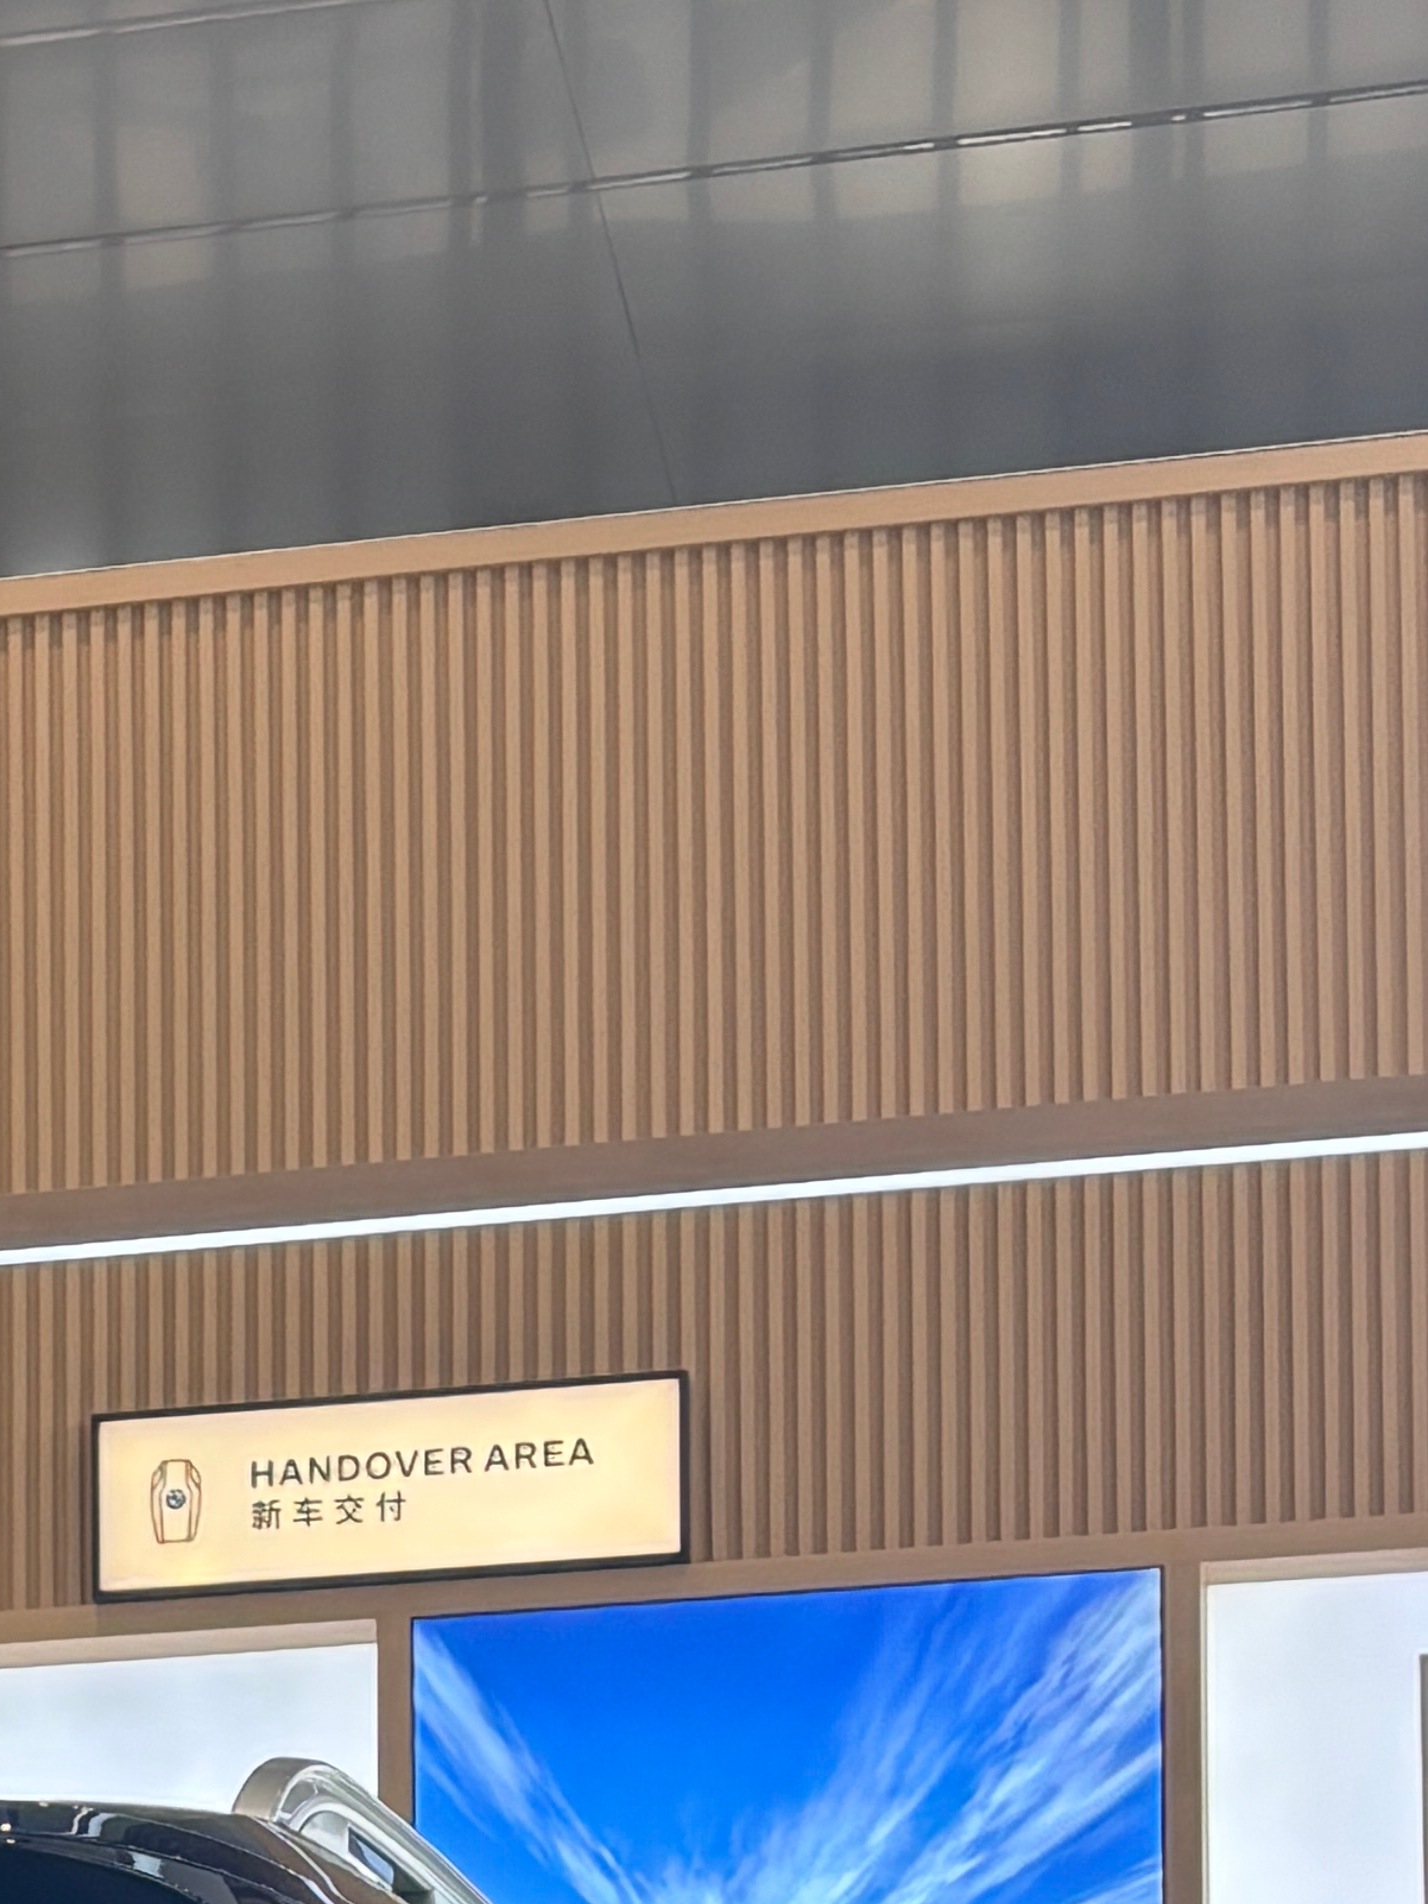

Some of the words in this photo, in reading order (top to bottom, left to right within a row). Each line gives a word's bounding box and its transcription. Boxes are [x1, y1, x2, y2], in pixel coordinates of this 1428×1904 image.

[250, 1446, 473, 1488] HANDOVER
[484, 1437, 595, 1472] AREA
[251, 1491, 406, 1530] 新车交付
